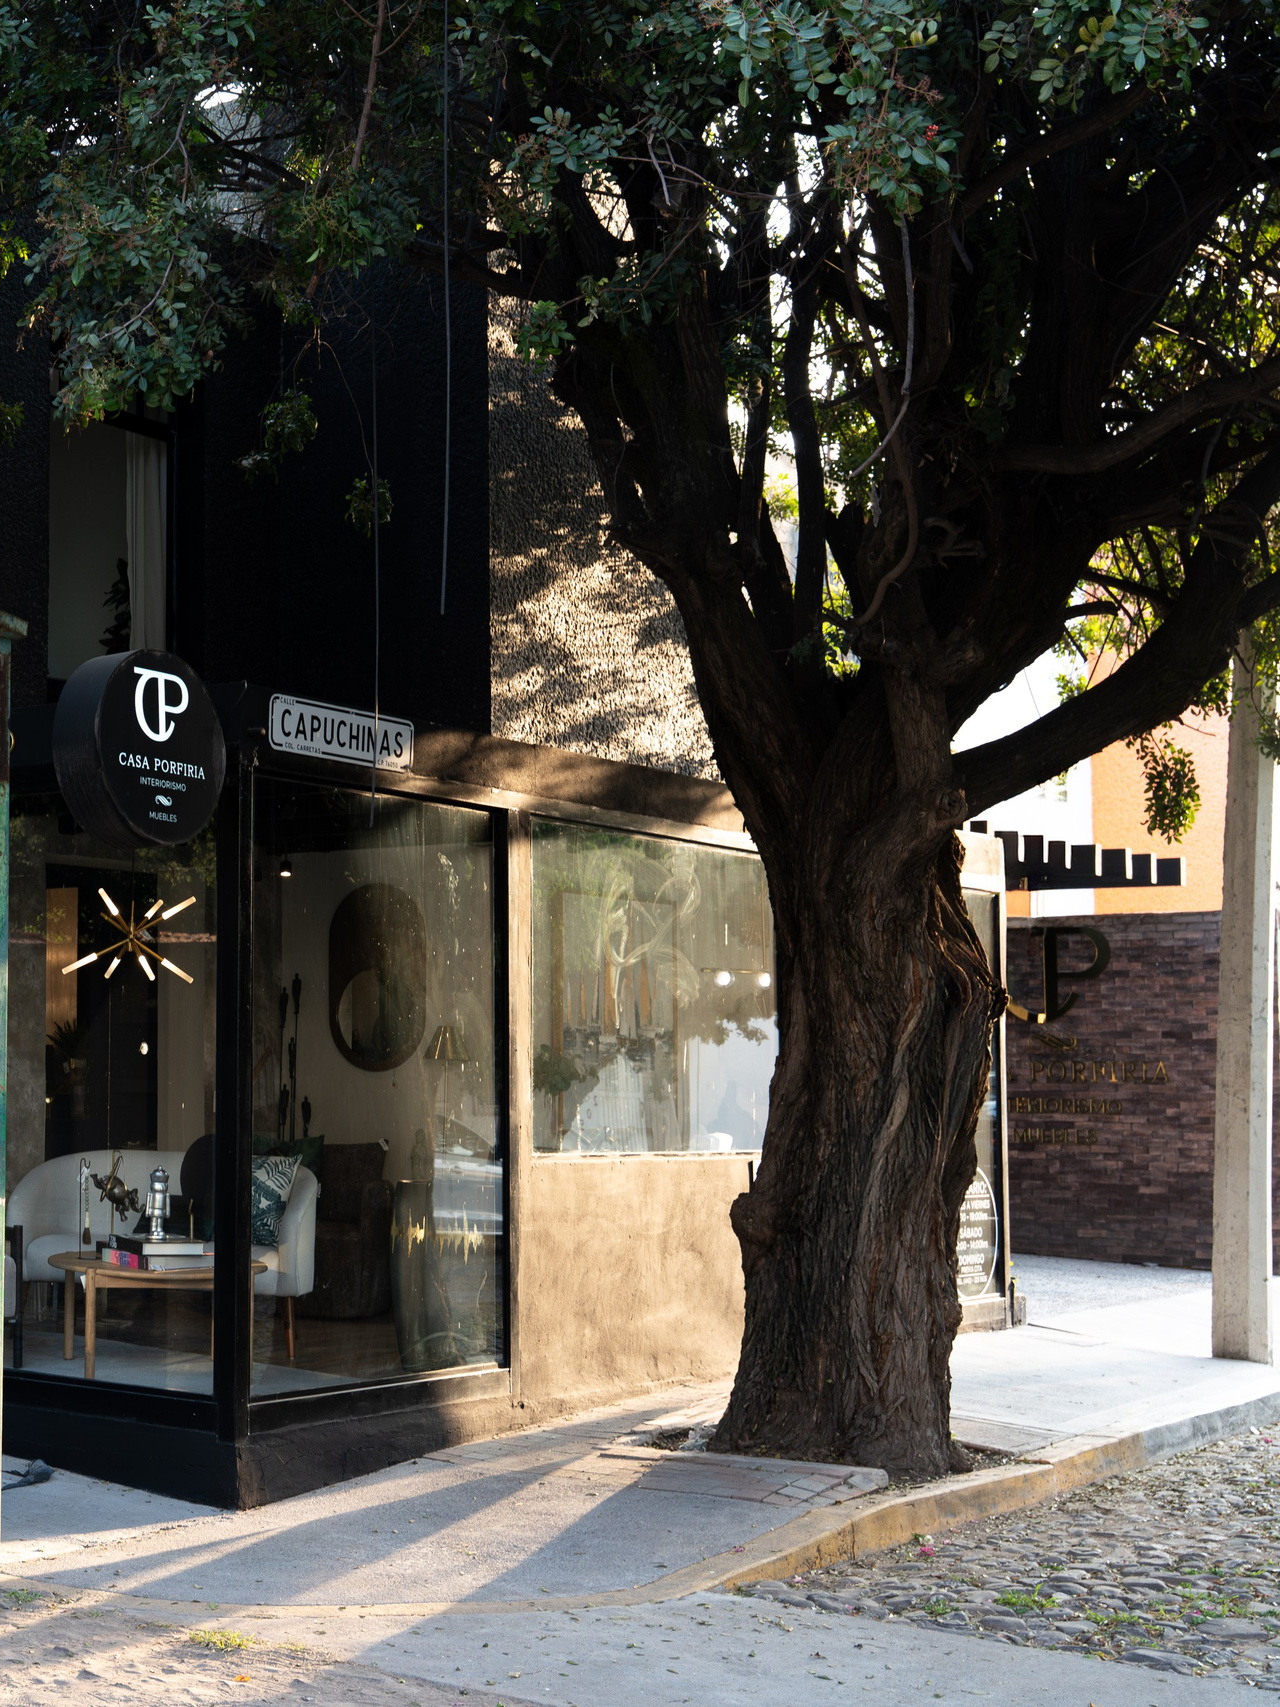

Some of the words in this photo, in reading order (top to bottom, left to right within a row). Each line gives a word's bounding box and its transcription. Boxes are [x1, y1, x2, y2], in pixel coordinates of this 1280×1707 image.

[280, 696, 295, 706] CALLE
[281, 708, 404, 758] CAPUCHINAS
[118, 751, 150, 770] CASA
[154, 757, 206, 780] PORFIRIA
[140, 776, 187, 792] INTERIORISMO
[149, 811, 178, 823] MUEBLES
[1031, 1060, 1169, 1084] PORFIRIA
[1013, 1127, 1098, 1144] MUEBLES
[960, 1225, 982, 1239] SÁBADO
[959, 1253, 985, 1265] DOMINGO
